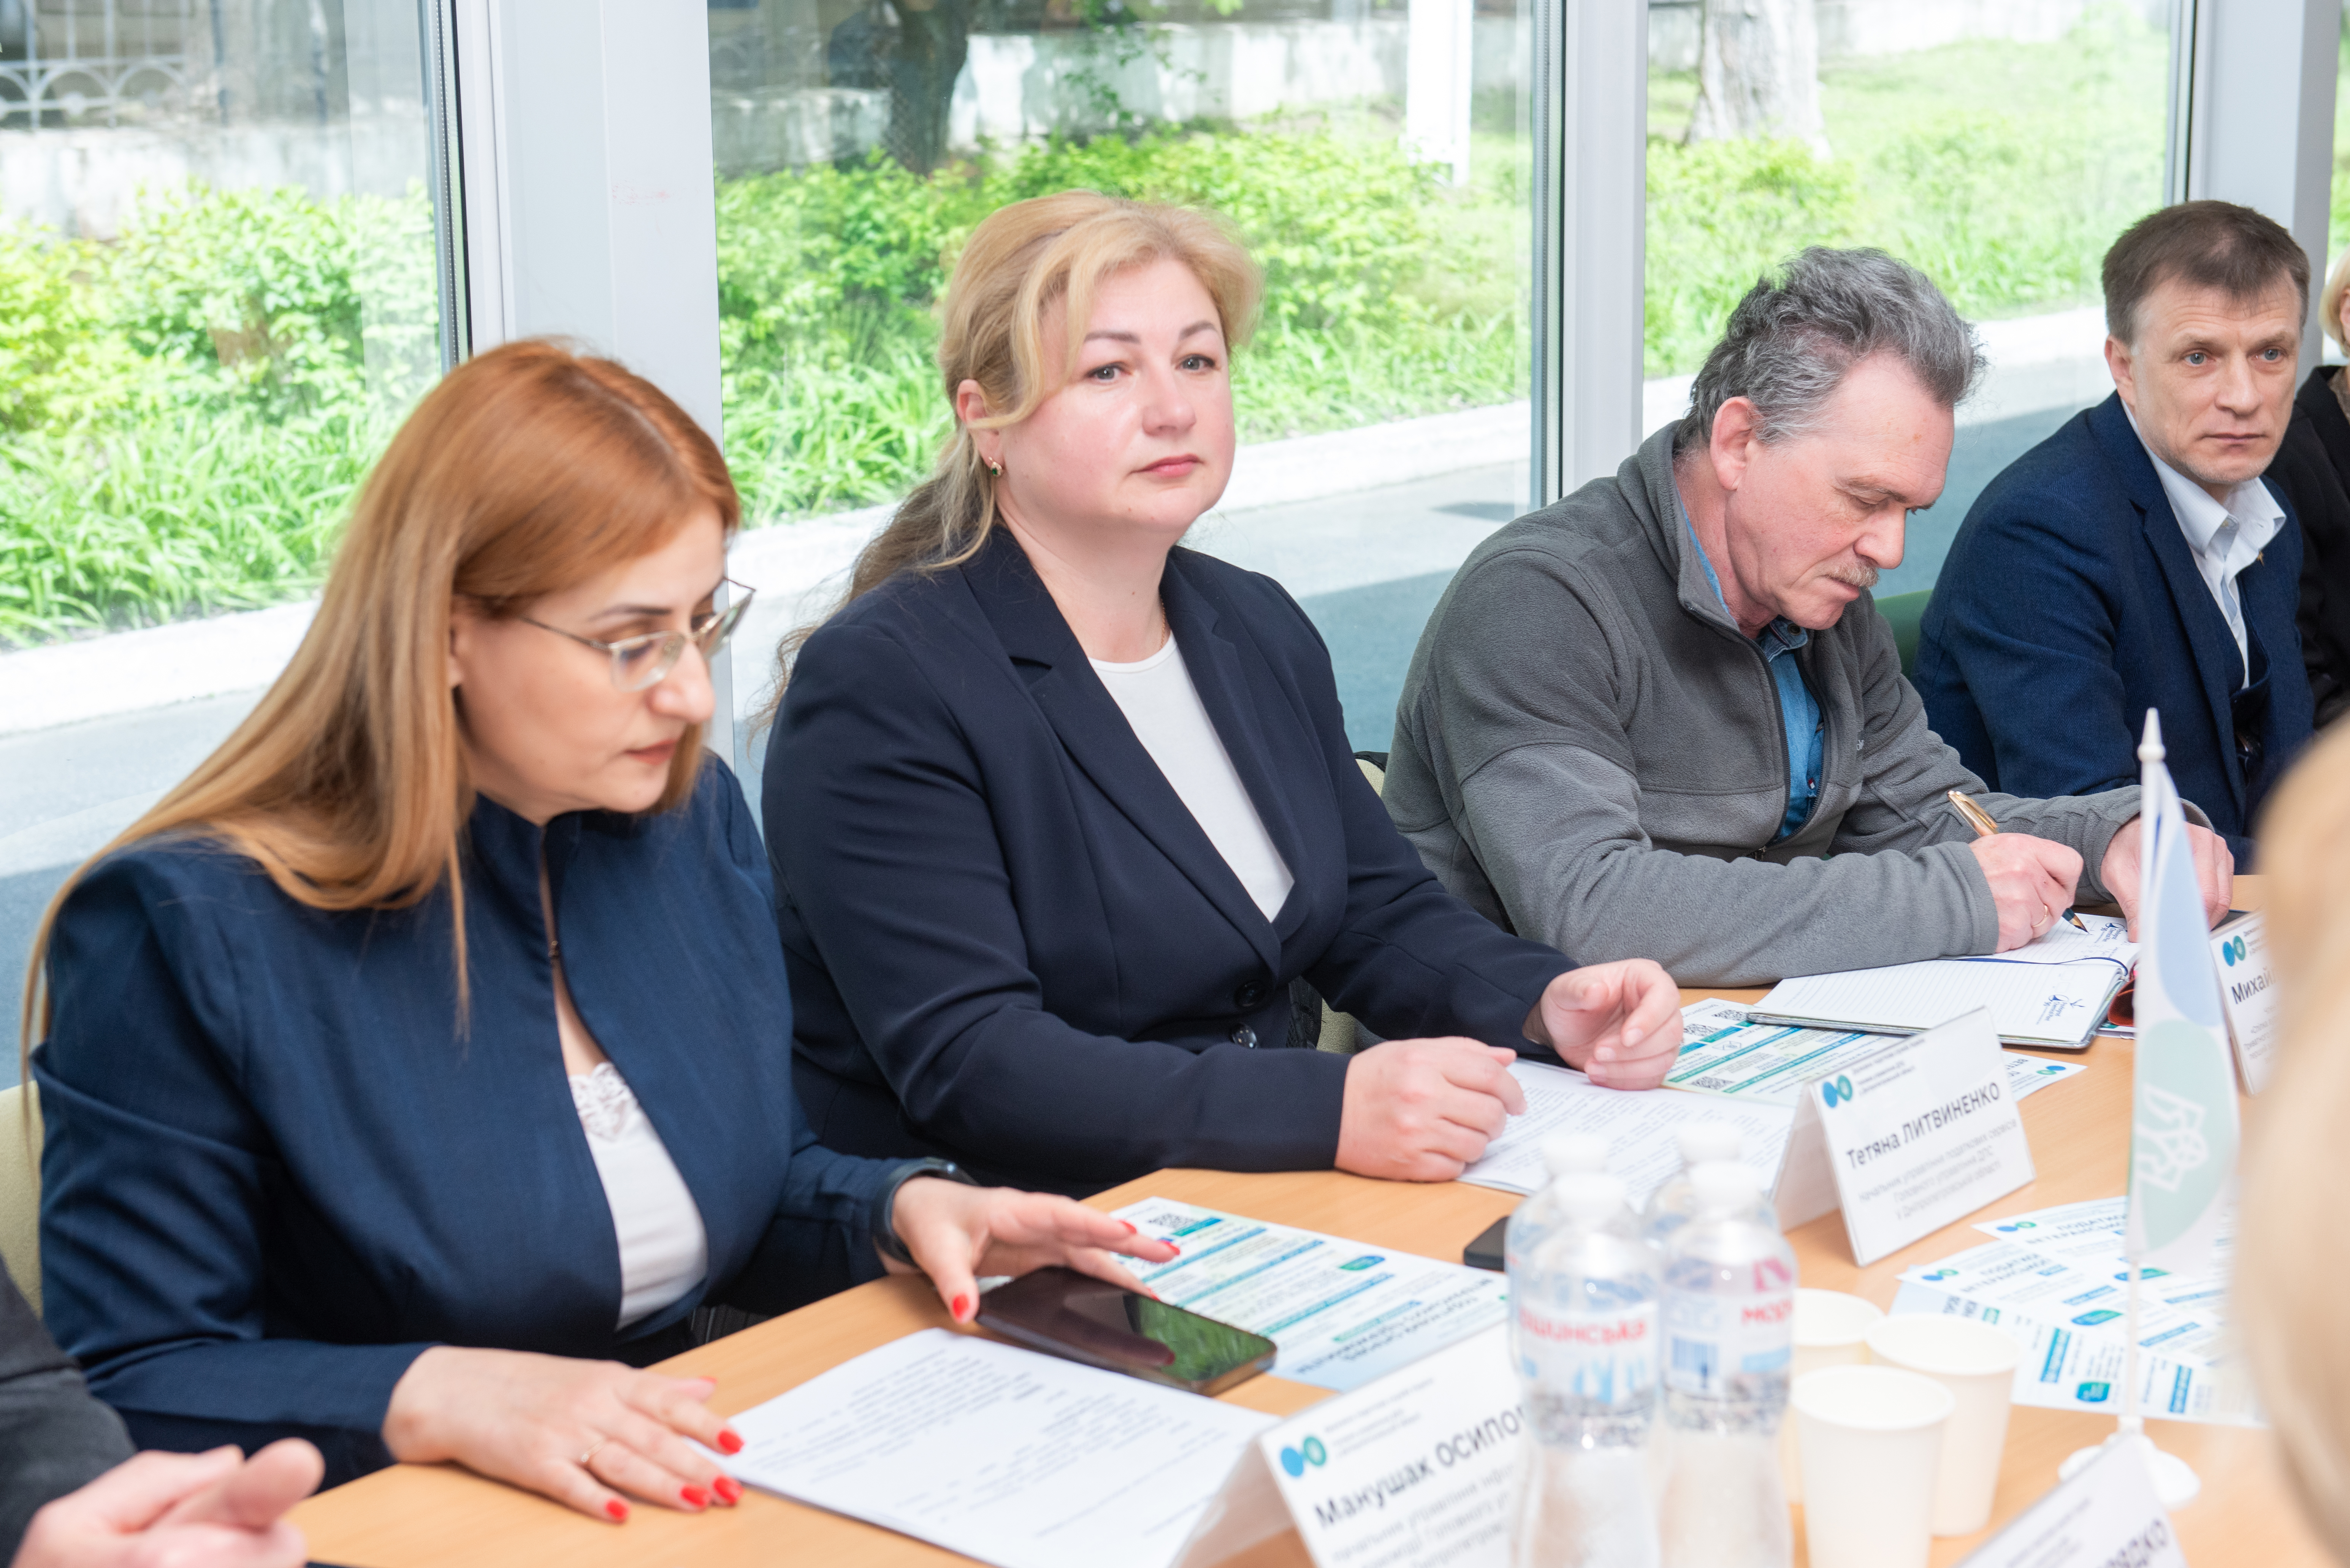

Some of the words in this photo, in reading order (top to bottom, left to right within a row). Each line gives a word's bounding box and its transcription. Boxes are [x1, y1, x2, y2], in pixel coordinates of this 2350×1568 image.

[2231, 966, 2276, 1005] Михай
[1846, 1133, 1900, 1169] Тетяна
[1902, 1082, 2000, 1144] ЛИТВИНЕНКО
[1314, 1456, 1435, 1529] Манушак
[1435, 1403, 1524, 1468] ОСИПО
